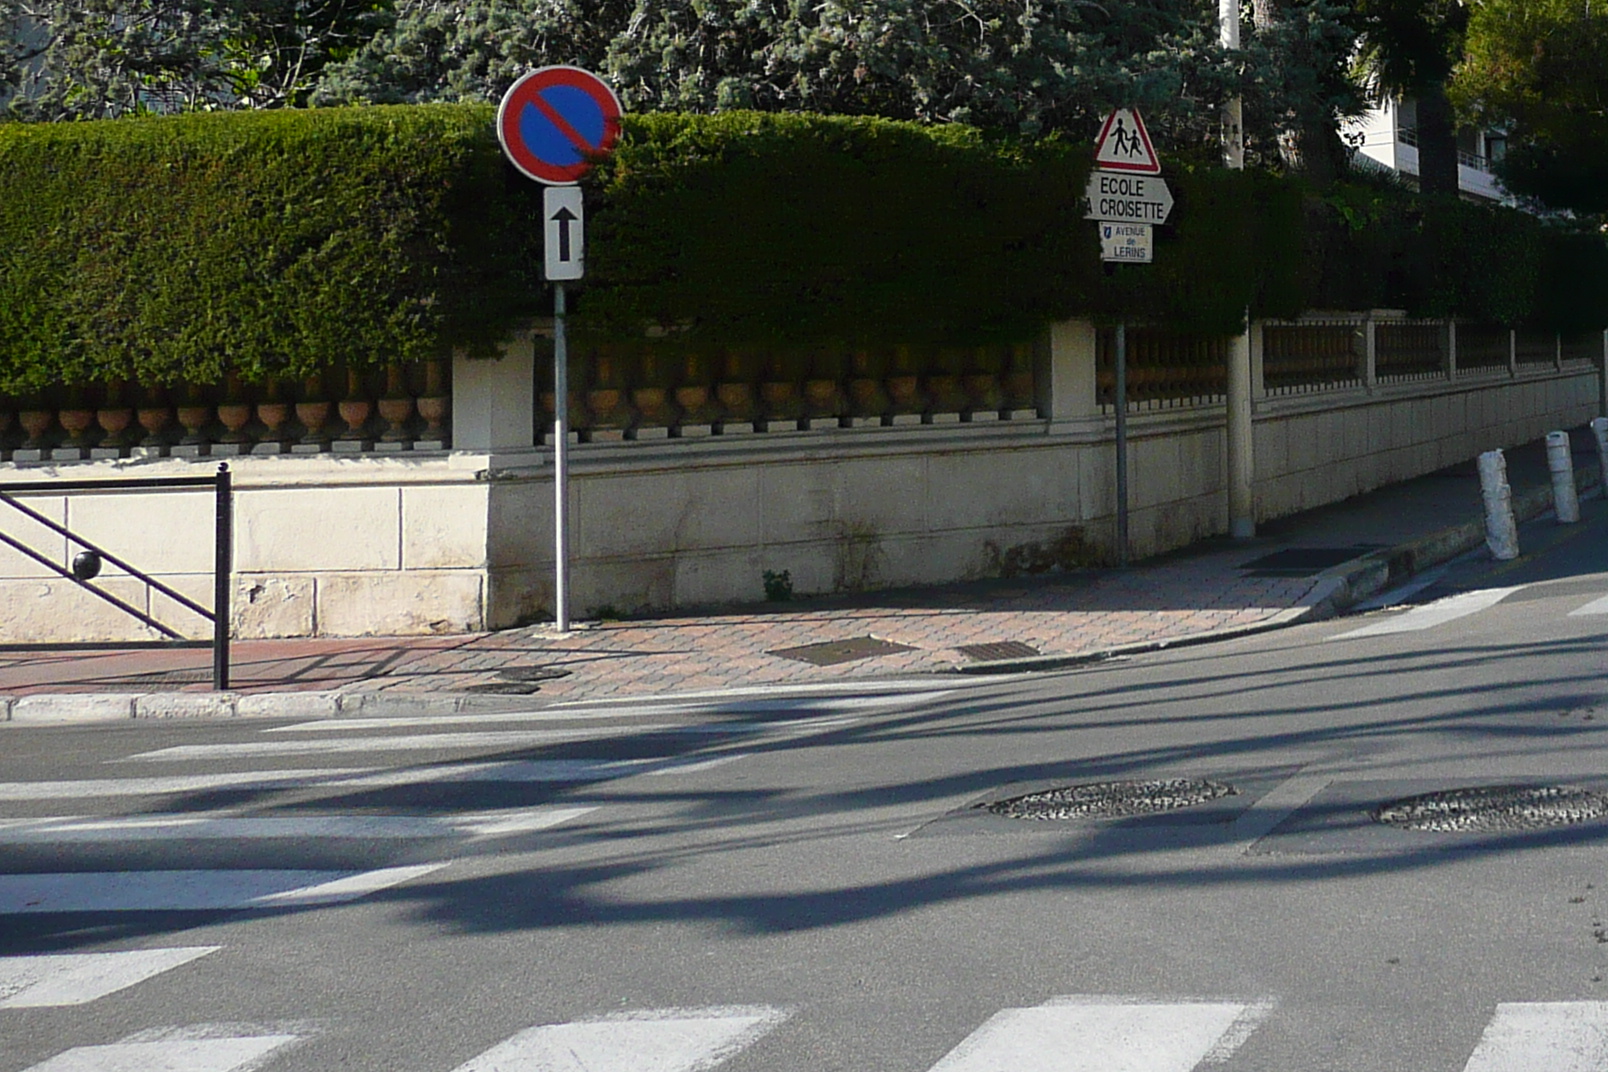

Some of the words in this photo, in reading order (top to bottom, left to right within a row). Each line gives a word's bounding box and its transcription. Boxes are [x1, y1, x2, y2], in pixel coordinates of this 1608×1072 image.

[1100, 177, 1144, 197] ECOLE
[1099, 198, 1164, 220] CROISETTE
[1115, 227, 1145, 237] AVENUE
[1126, 238, 1135, 246] de
[1114, 246, 1146, 259] LERINS
